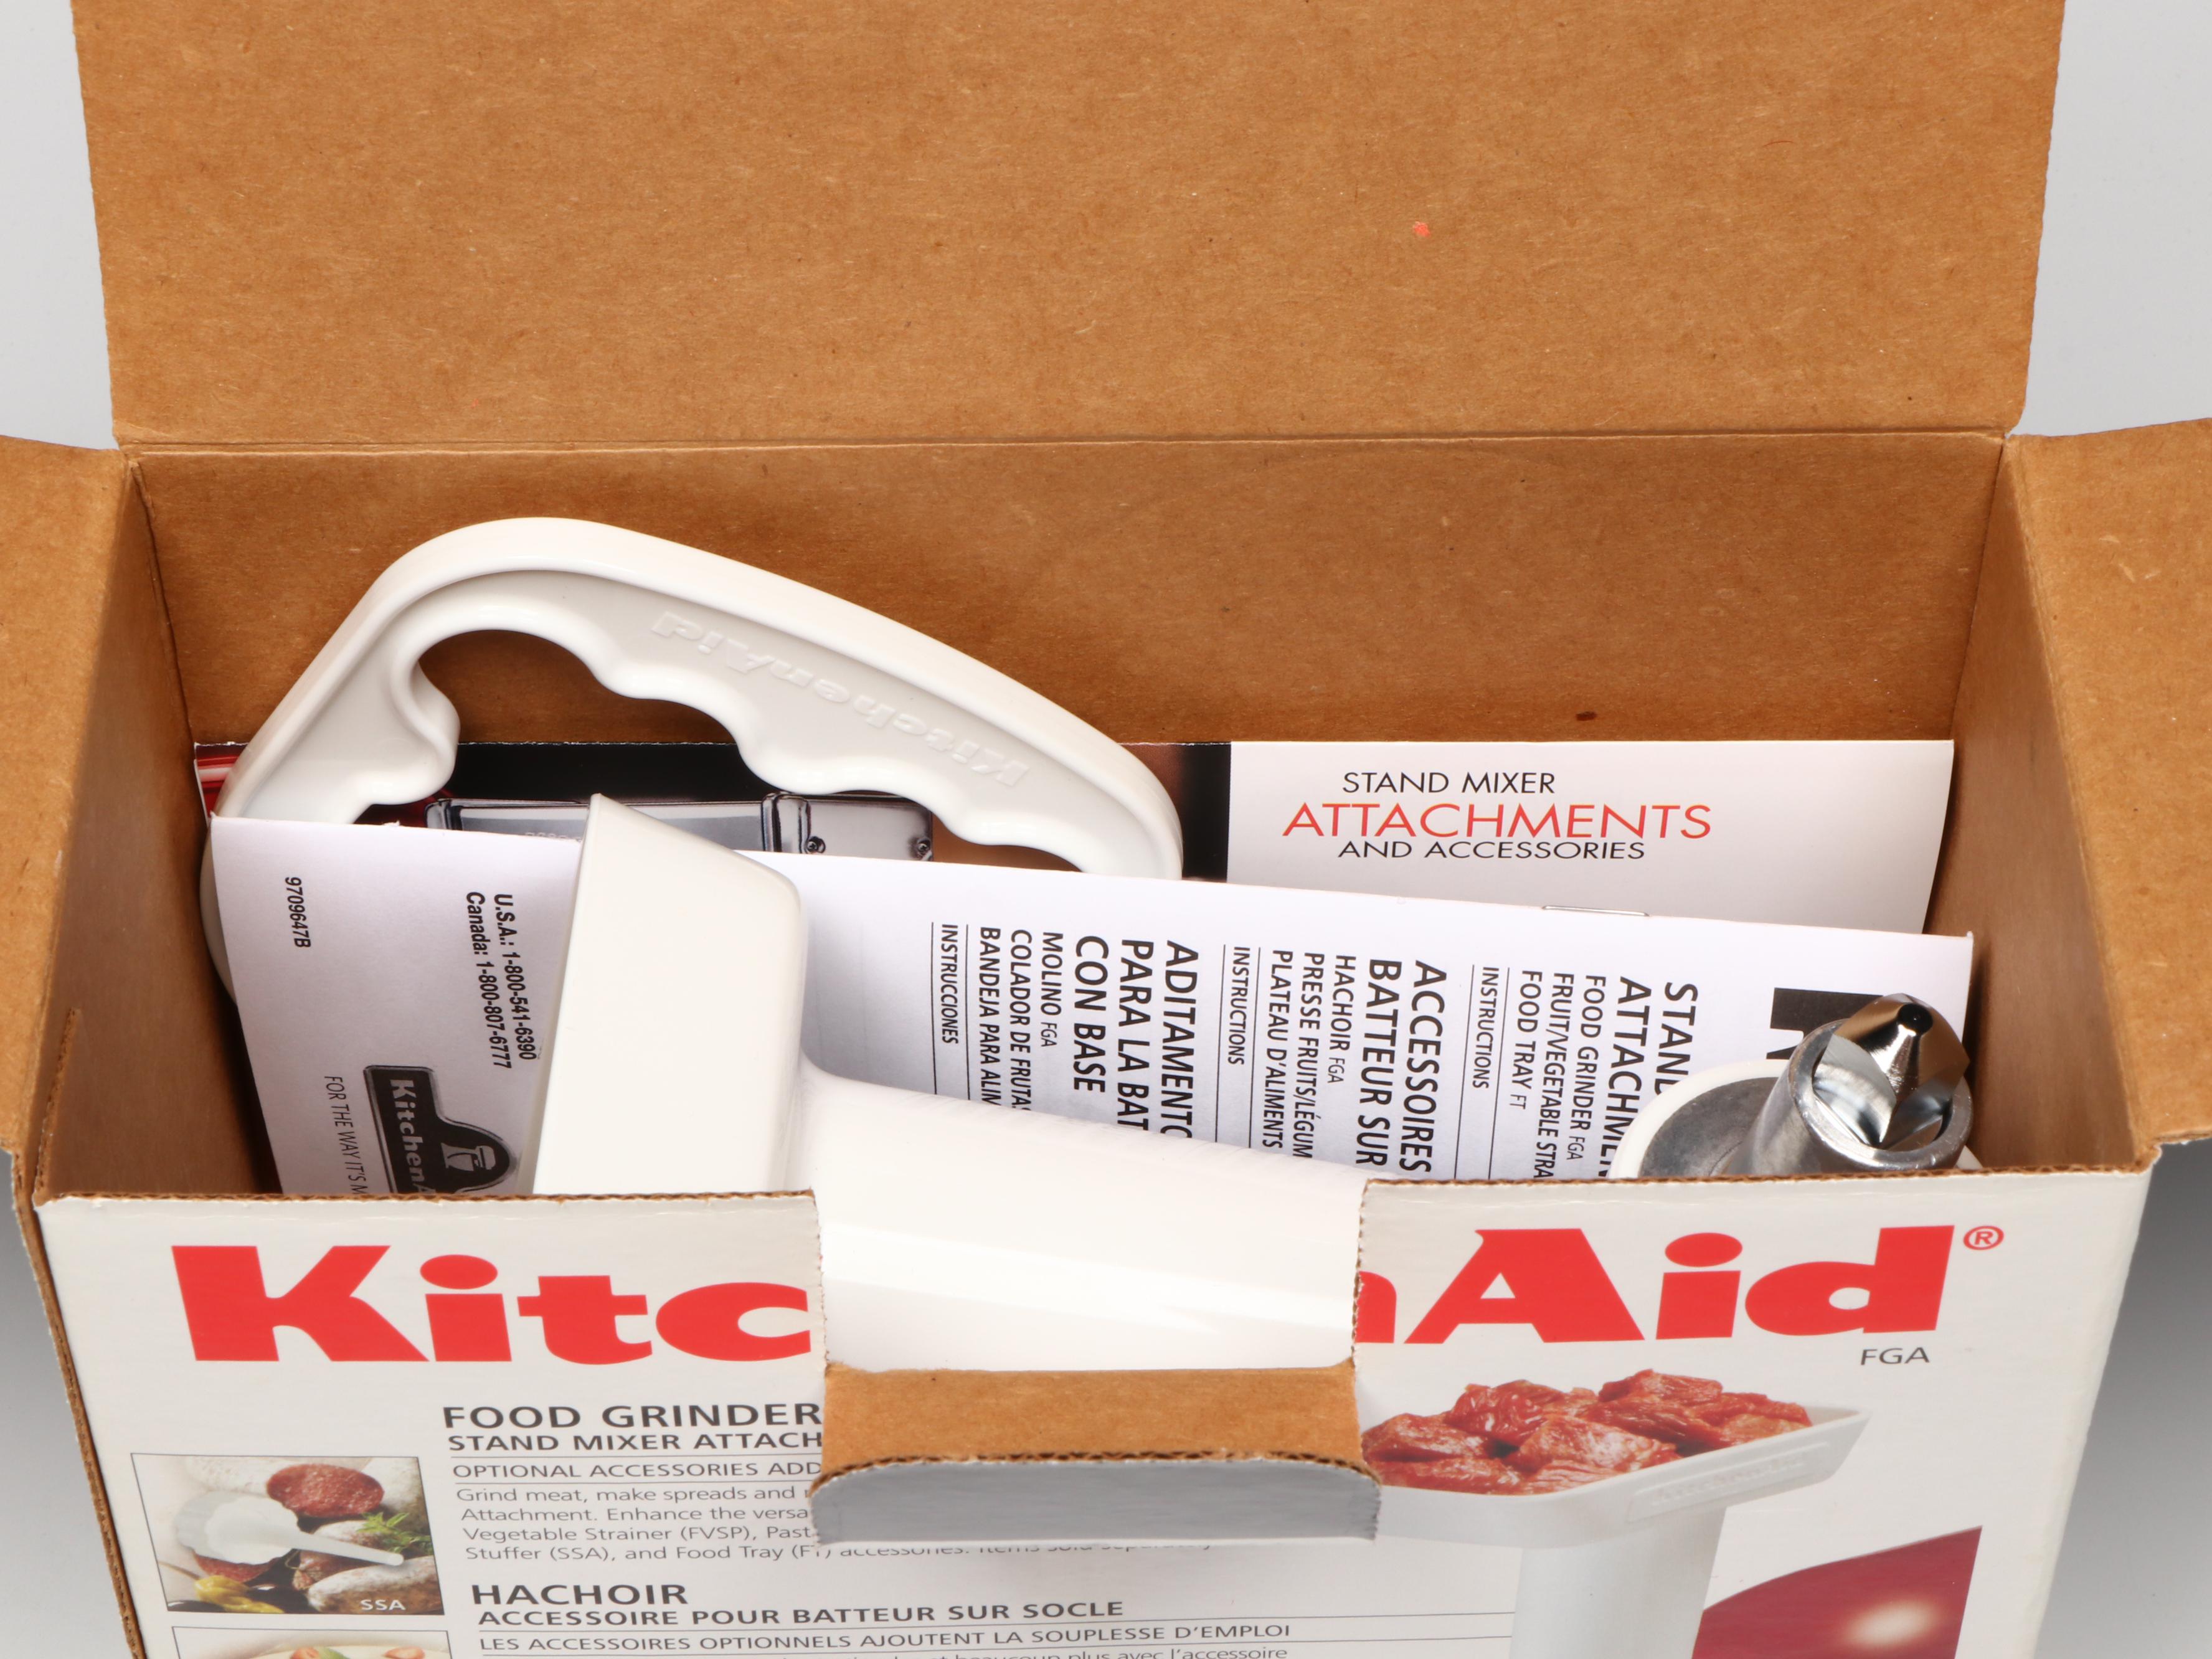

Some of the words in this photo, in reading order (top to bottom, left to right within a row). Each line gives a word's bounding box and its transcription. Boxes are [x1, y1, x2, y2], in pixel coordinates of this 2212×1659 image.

[1343, 772, 1449, 793] STAND
[1462, 772, 1554, 793] MIXER
[1283, 803, 1711, 839] ATTACHMENTS
[1338, 841, 1412, 858] AND
[1425, 841, 1644, 859] ACCESSORIES
[285, 877, 311, 947] 9709647B
[466, 892, 491, 955] Canada:
[494, 894, 517, 945] U.S.A.:
[940, 924, 958, 1044] INSTRUCCIONES
[979, 927, 1001, 1017] BANDEJA
[1009, 930, 1032, 1025] COLADOR
[1041, 932, 1063, 1015] MOLINO
[1074, 936, 1108, 1011] CON
[1118, 940, 1154, 1027] PARA
[1300, 953, 1325, 1029] PRESSE
[476, 962, 512, 1068] 1-800-807-6777
[502, 953, 536, 1061] 1-800-541-6390
[1228, 947, 1250, 1064] INSTRUCTIONS
[1267, 950, 1293, 1041] PLATEAU
[1330, 955, 1356, 1051] HACHOIR
[1518, 971, 1543, 1033] FOOD
[1581, 975, 1606, 1037] FOOD
[980, 1024, 1000, 1064] PARA
[1010, 1031, 1030, 1053] DE
[1041, 1022, 1057, 1047] FGA
[1359, 960, 1402, 1105] BATTEUR
[1472, 967, 1499, 1088] INSTRUCTIONS
[1073, 1023, 1106, 1092] BASE
[1118, 1039, 1150, 1072] LA
[1328, 1057, 1345, 1083] FGA
[1399, 960, 1447, 1172] ACCESSOIRES
[1512, 1041, 1536, 1089] TRAY
[1538, 973, 1574, 1138] FRUIT/VEGETABLE
[324, 1076, 346, 1100] FOR
[1262, 1048, 1287, 1148] D'ALIMENTS
[1510, 1094, 1526, 1109] FT
[1571, 1047, 1599, 1133] GRINDER
[331, 1104, 353, 1127] THE
[338, 1132, 361, 1158] WAY
[1356, 1115, 1390, 1166] SUR
[1567, 1136, 1585, 1160] FGA
[345, 1162, 366, 1181] IT'S
[1861, 1347, 1929, 1365] FGA
[443, 1407, 580, 1429] FOOD
[602, 1403, 821, 1428] GRINDER
[448, 1435, 559, 1450] STAND
[574, 1435, 681, 1450] MIXER
[453, 1465, 581, 1477] OPTIONAL
[590, 1463, 758, 1477] ACCESSORIES
[768, 1462, 821, 1475] ADD
[457, 1488, 517, 1501] Grind
[526, 1490, 587, 1503] meat,
[597, 1488, 656, 1501] make
[663, 1486, 747, 1503] spreads
[754, 1486, 795, 1499] and
[461, 1508, 597, 1521] Attachment.
[607, 1508, 702, 1520] Enhance
[710, 1506, 745, 1520] the
[463, 1528, 577, 1543] Vegetable
[585, 1528, 671, 1540] Strainer
[681, 1526, 756, 1541] (FVSP),
[465, 1545, 545, 1561] Stuffer
[550, 1547, 615, 1561] (SSA),
[625, 1546, 666, 1559] and
[677, 1546, 730, 1559] Food
[739, 1546, 783, 1561] Tray
[360, 1599, 406, 1611] SSA
[472, 1585, 688, 1605] HACHOIR
[479, 1611, 678, 1625] ACCESSOIRE
[692, 1610, 780, 1624] POUR
[793, 1607, 935, 1624] BATTEUR
[948, 1605, 1009, 1620] SUR
[1023, 1602, 1122, 1618] SOCLE
[480, 1639, 519, 1650] LES
[529, 1638, 690, 1650] ACCESSOIRES
[700, 1636, 851, 1649] OPTIONNELS
[860, 1633, 985, 1647] AJOUTENT
[995, 1632, 1023, 1643] LA
[1032, 1628, 1164, 1642] SOUPLESSE
